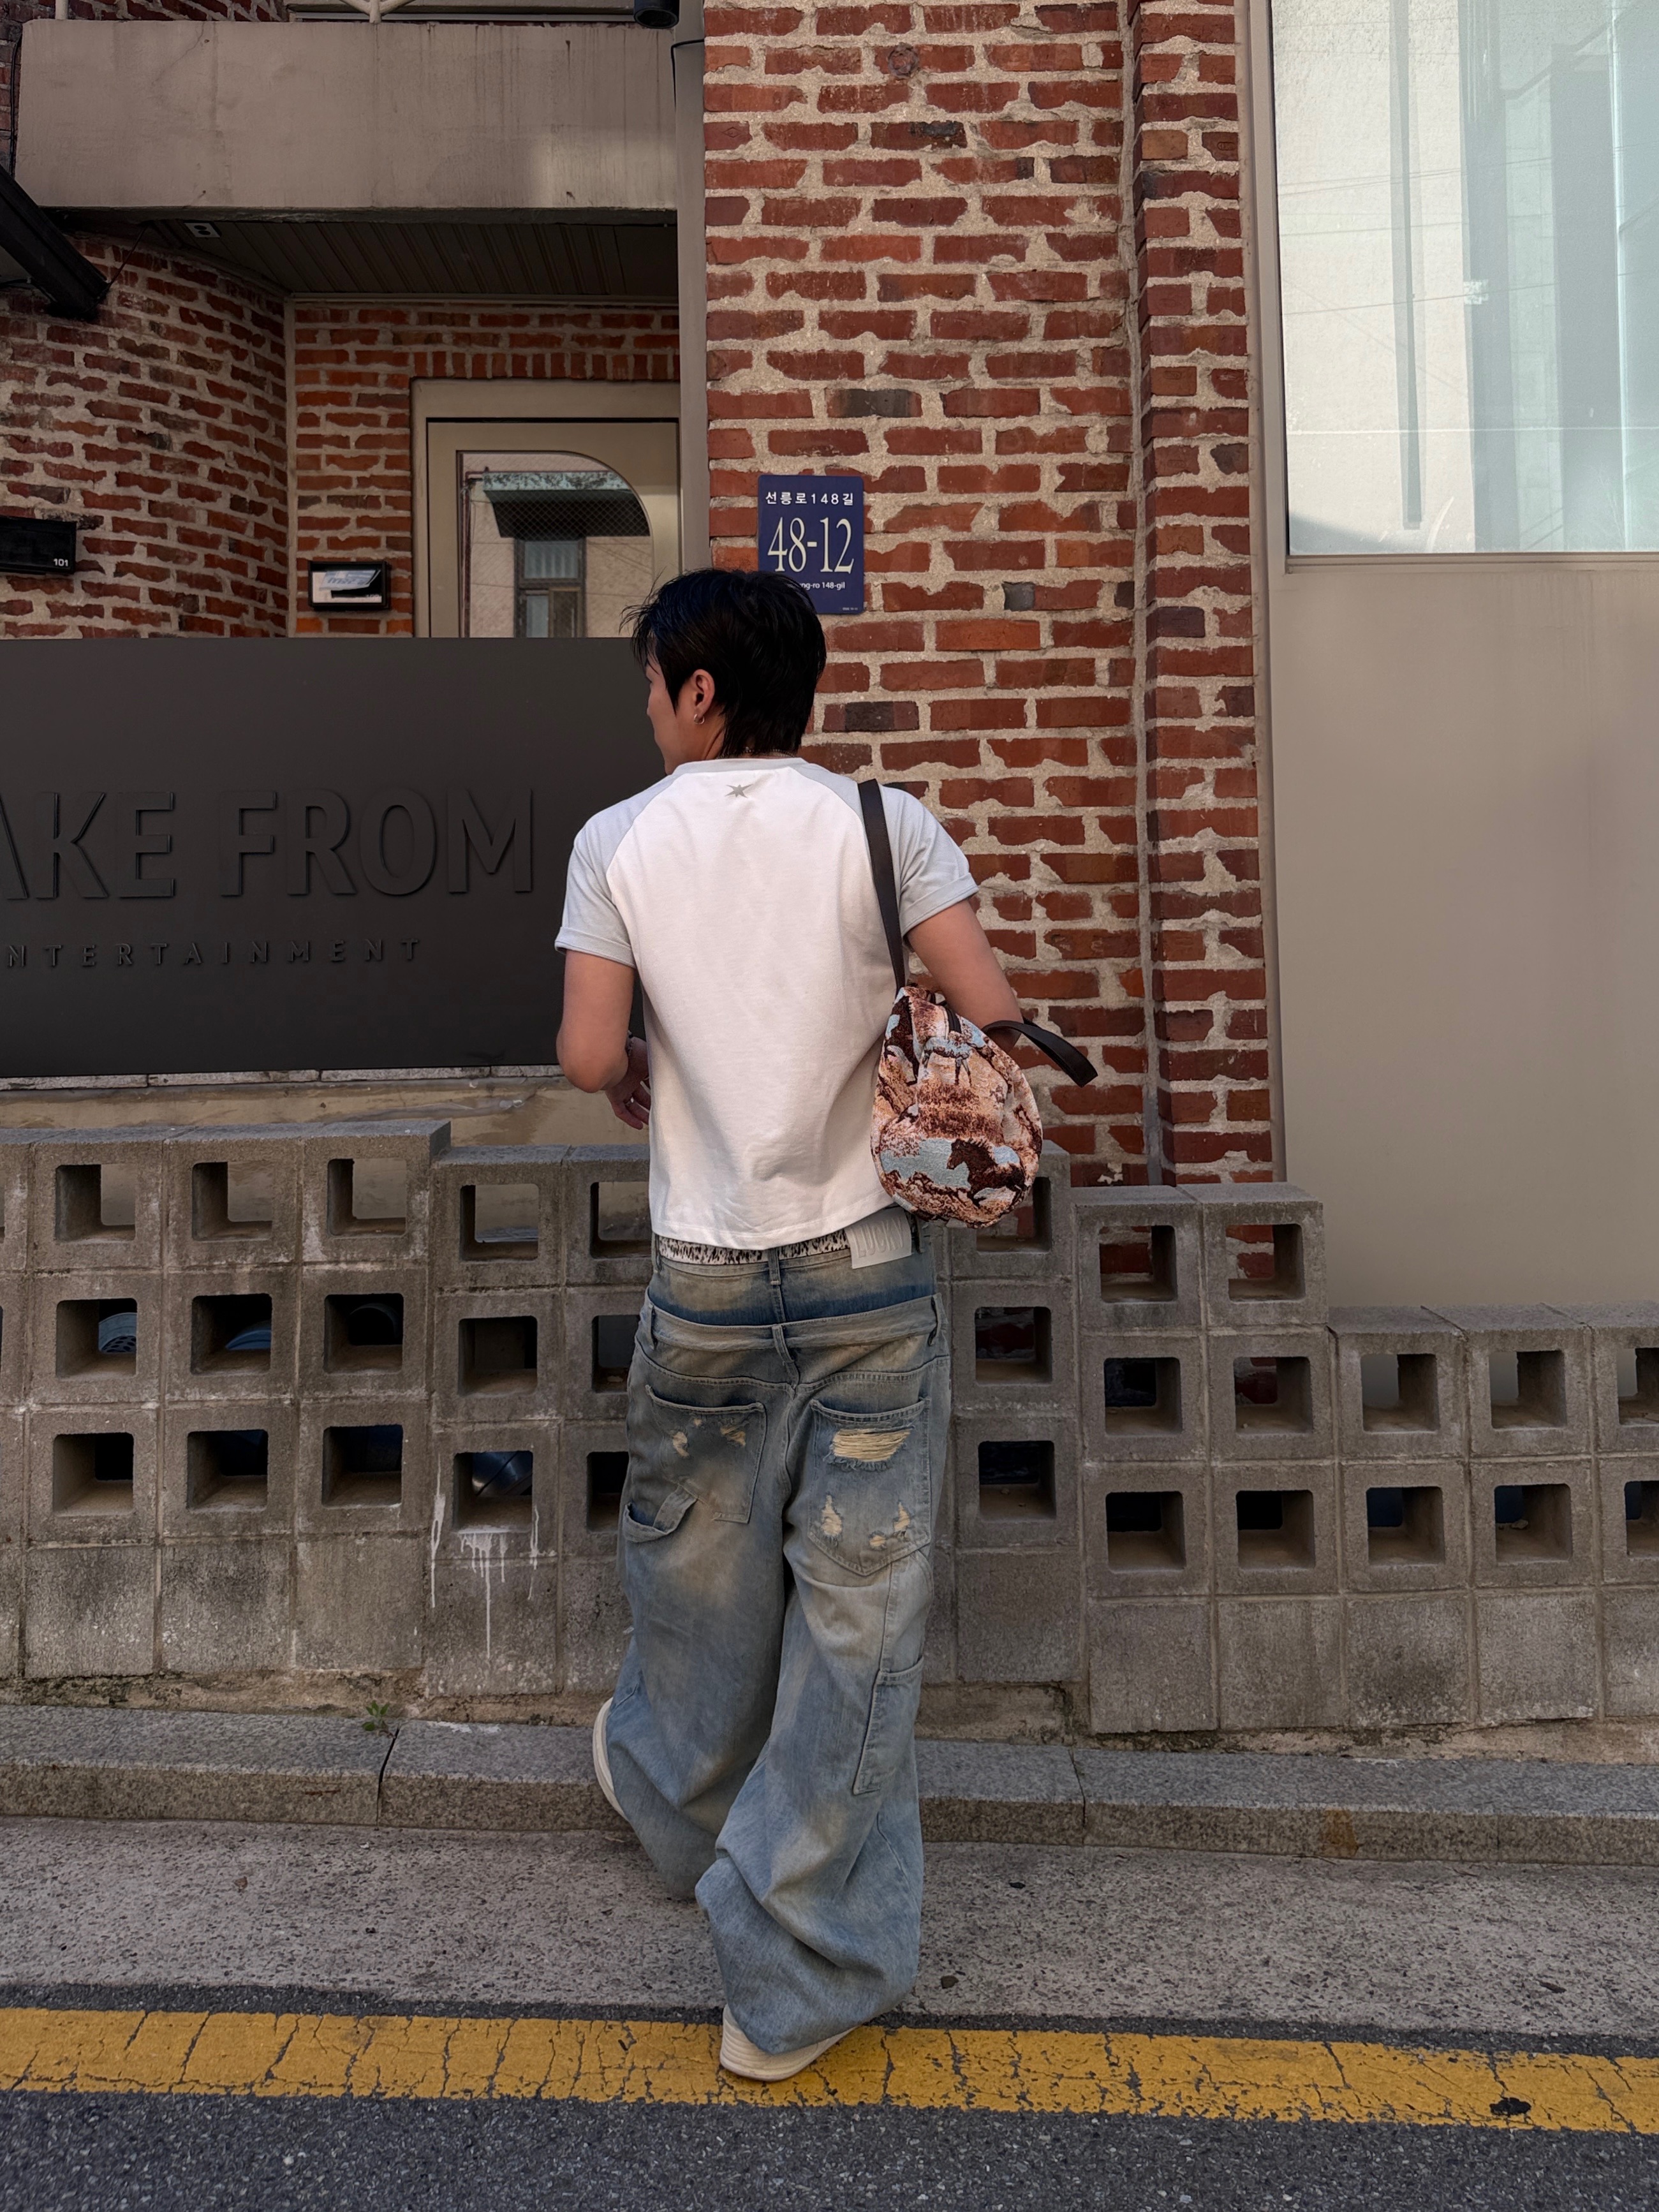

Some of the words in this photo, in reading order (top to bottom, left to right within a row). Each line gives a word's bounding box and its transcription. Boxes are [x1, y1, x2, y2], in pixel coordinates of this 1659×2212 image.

[53, 558, 69, 567] 101
[767, 517, 854, 574] 48-12
[822, 582, 845, 591] 148-gil
[220, 787, 533, 898] FROM
[850, 1217, 904, 1258] LUCKY
